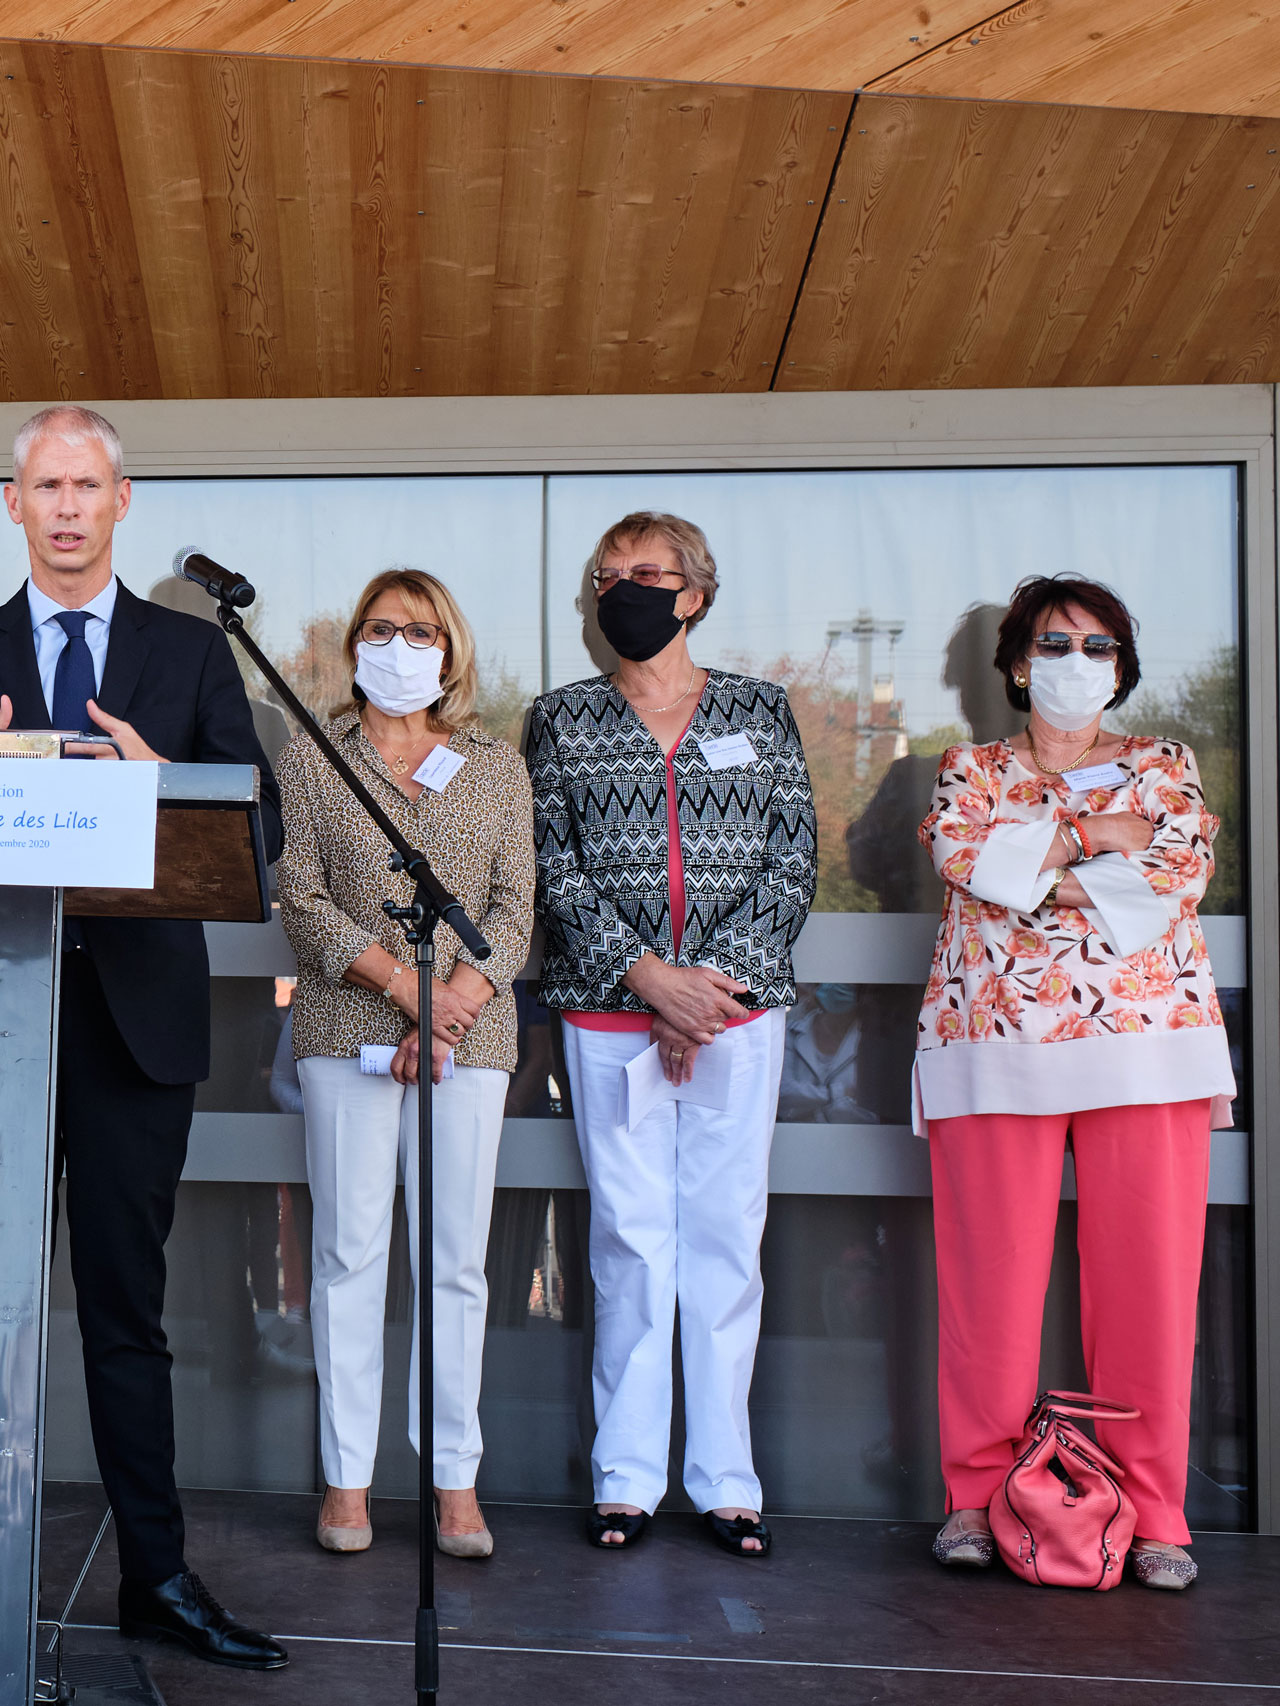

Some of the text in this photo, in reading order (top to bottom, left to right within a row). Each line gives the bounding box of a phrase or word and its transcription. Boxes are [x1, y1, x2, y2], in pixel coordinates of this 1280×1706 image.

[12, 809, 46, 829] des
[53, 810, 98, 830] Lilas
[28, 839, 51, 849] 2020
